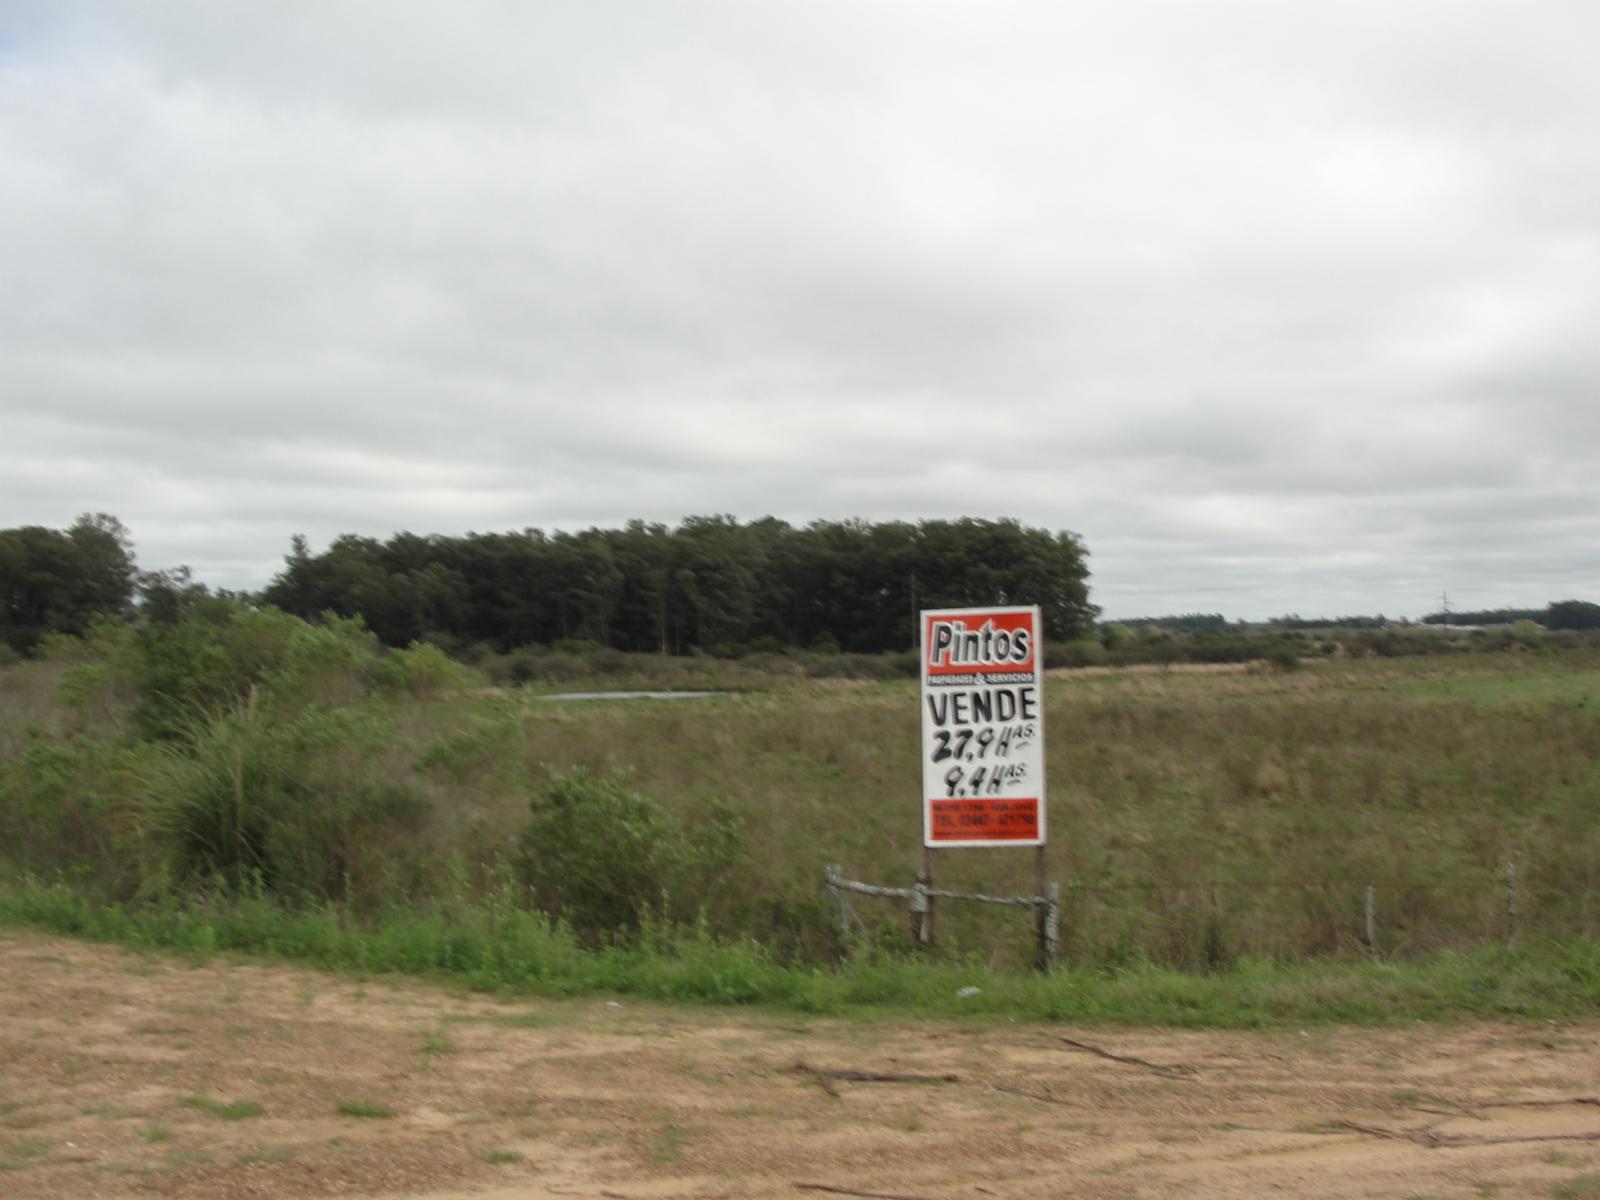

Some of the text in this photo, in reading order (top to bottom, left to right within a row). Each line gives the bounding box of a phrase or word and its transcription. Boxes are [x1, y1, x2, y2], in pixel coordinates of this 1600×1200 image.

[929, 618, 1031, 667] Pintos
[986, 673, 1034, 683] SERVICIOS
[927, 687, 1036, 726] VENDE
